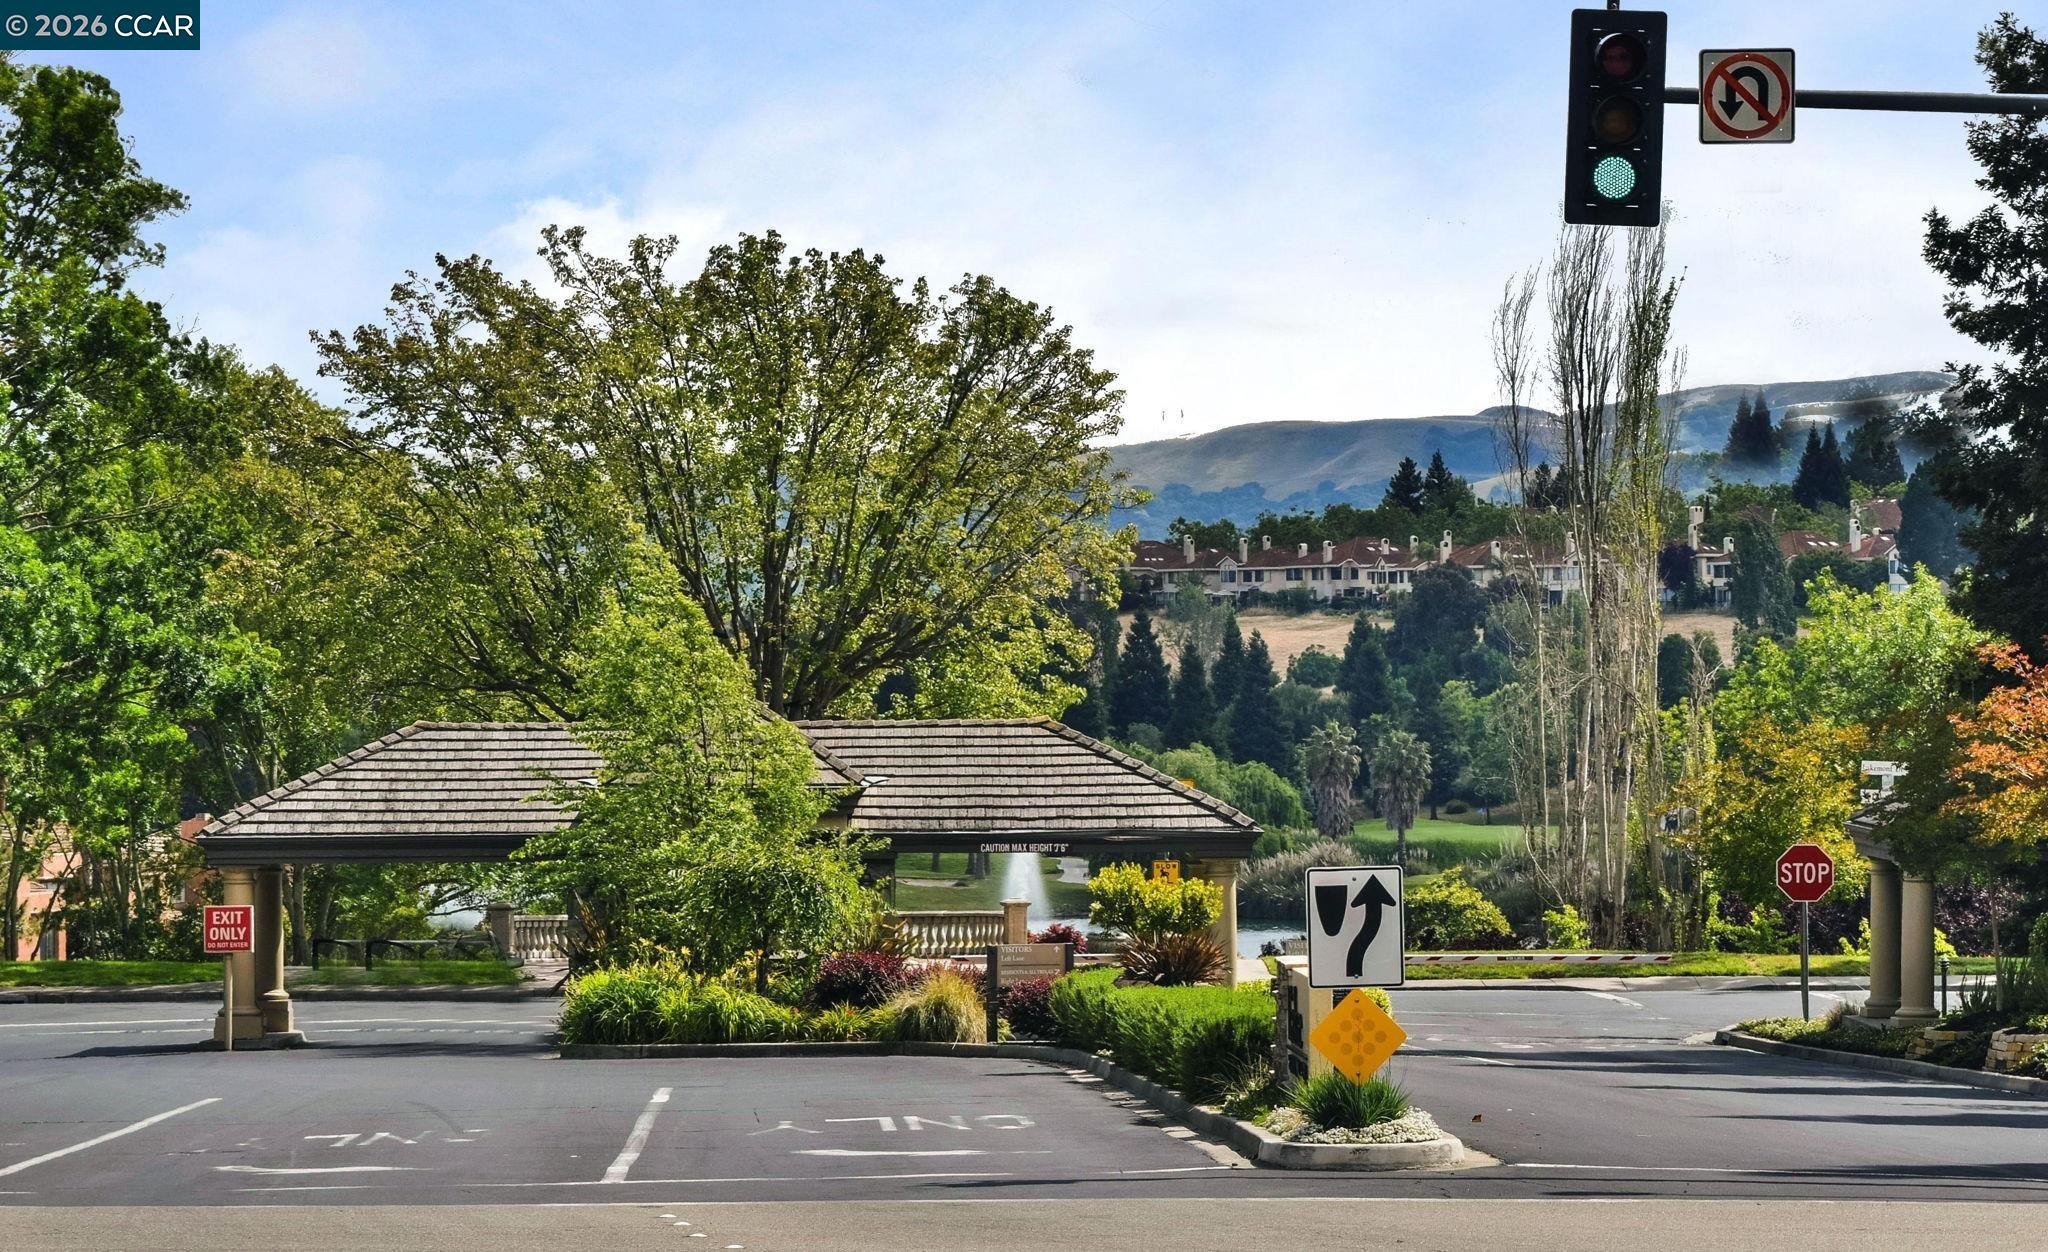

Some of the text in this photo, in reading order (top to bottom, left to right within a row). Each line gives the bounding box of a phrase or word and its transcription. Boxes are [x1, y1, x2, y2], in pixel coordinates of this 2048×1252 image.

[980, 843, 1010, 853] CAUTION
[1011, 843, 1028, 853] MAX
[1029, 843, 1052, 853] HEIGHT
[1780, 862, 1830, 884] STOP
[212, 911, 244, 925] EXIT
[209, 927, 247, 941] ONLY
[747, 1114, 1037, 1137] ONLY
